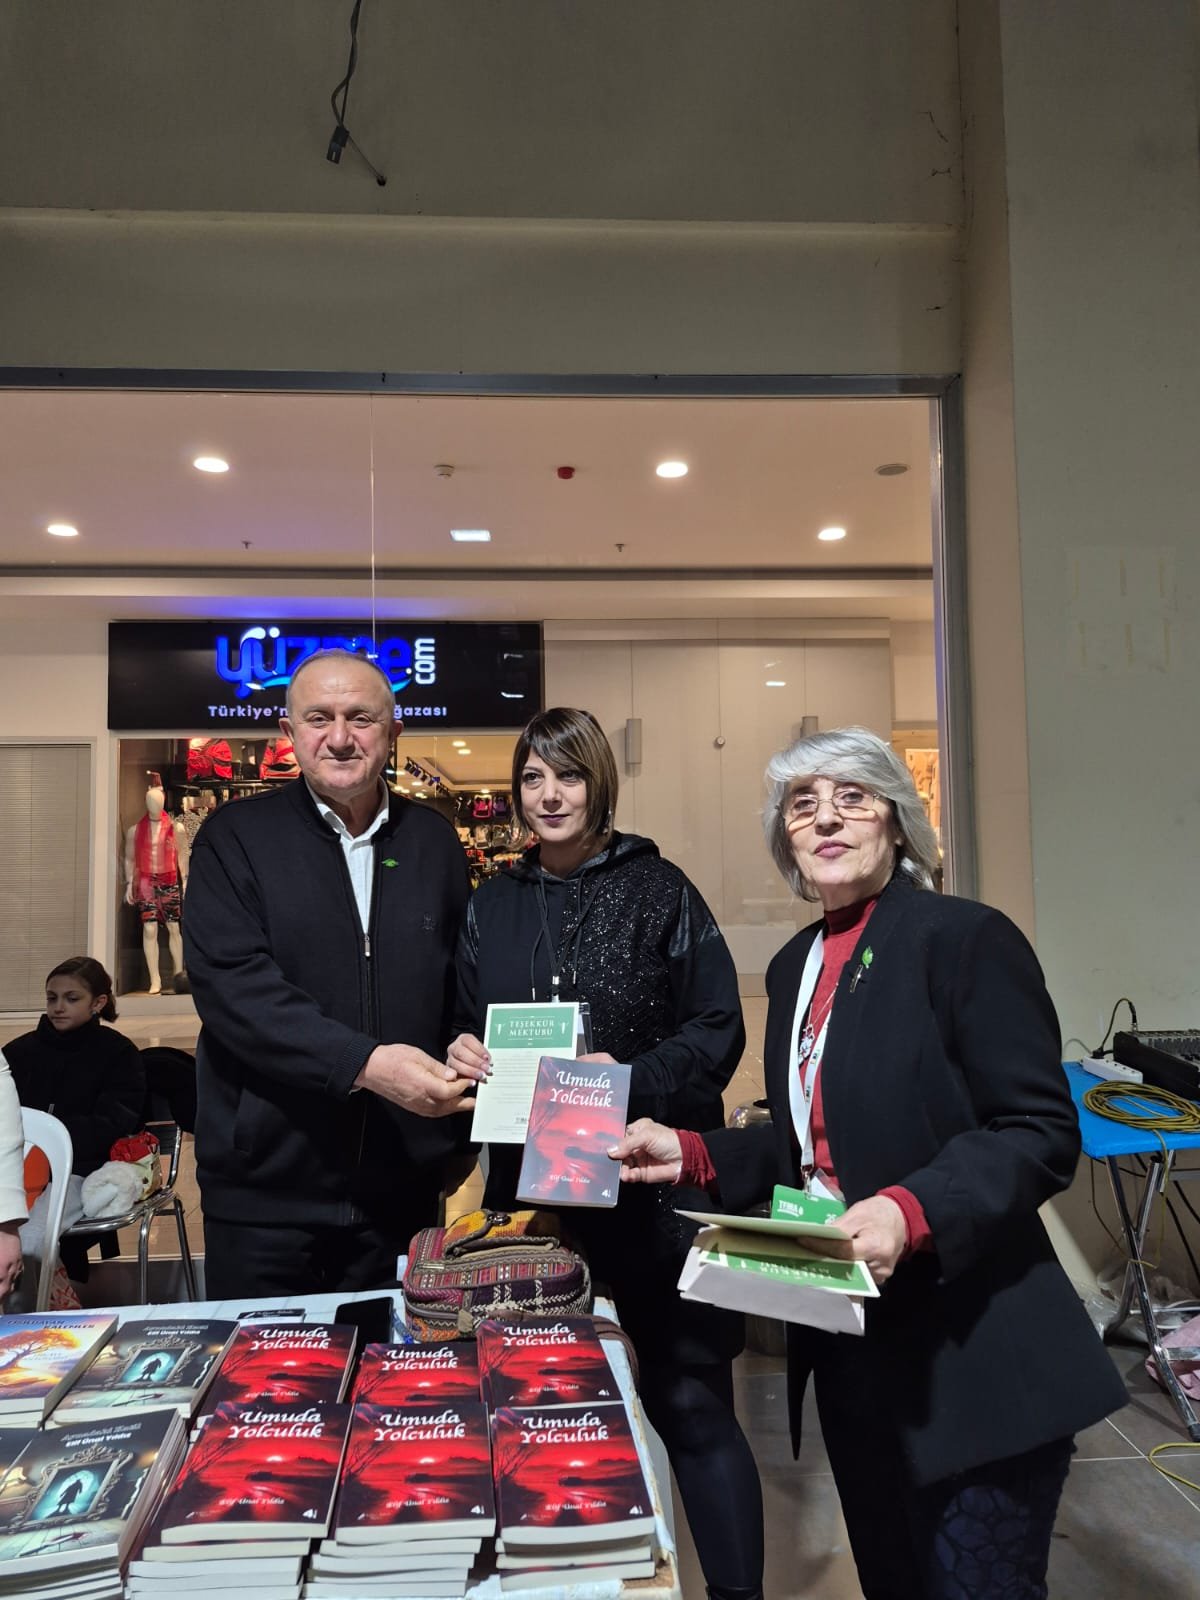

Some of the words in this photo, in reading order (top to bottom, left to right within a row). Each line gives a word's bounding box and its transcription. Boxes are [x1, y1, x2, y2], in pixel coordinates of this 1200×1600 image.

[393, 704, 447, 719] ğazası
[509, 1028, 553, 1036] MEKTUBU
[556, 1070, 611, 1089] Umuda
[549, 1087, 614, 1108] Yolculuk
[259, 1326, 328, 1339] Umuda
[503, 1322, 571, 1336] Umuda
[250, 1337, 332, 1351] Yolculuk
[502, 1332, 578, 1346] Yolculuk
[386, 1346, 455, 1360] Umuda
[381, 1356, 459, 1371] Yolculuk
[239, 1407, 321, 1424] Umuda
[380, 1408, 461, 1427] Umuda
[522, 1411, 602, 1429] Umuda
[227, 1422, 325, 1439] Yolculuk
[374, 1422, 466, 1441] Yolculuk
[519, 1424, 609, 1444] Yolculuk
